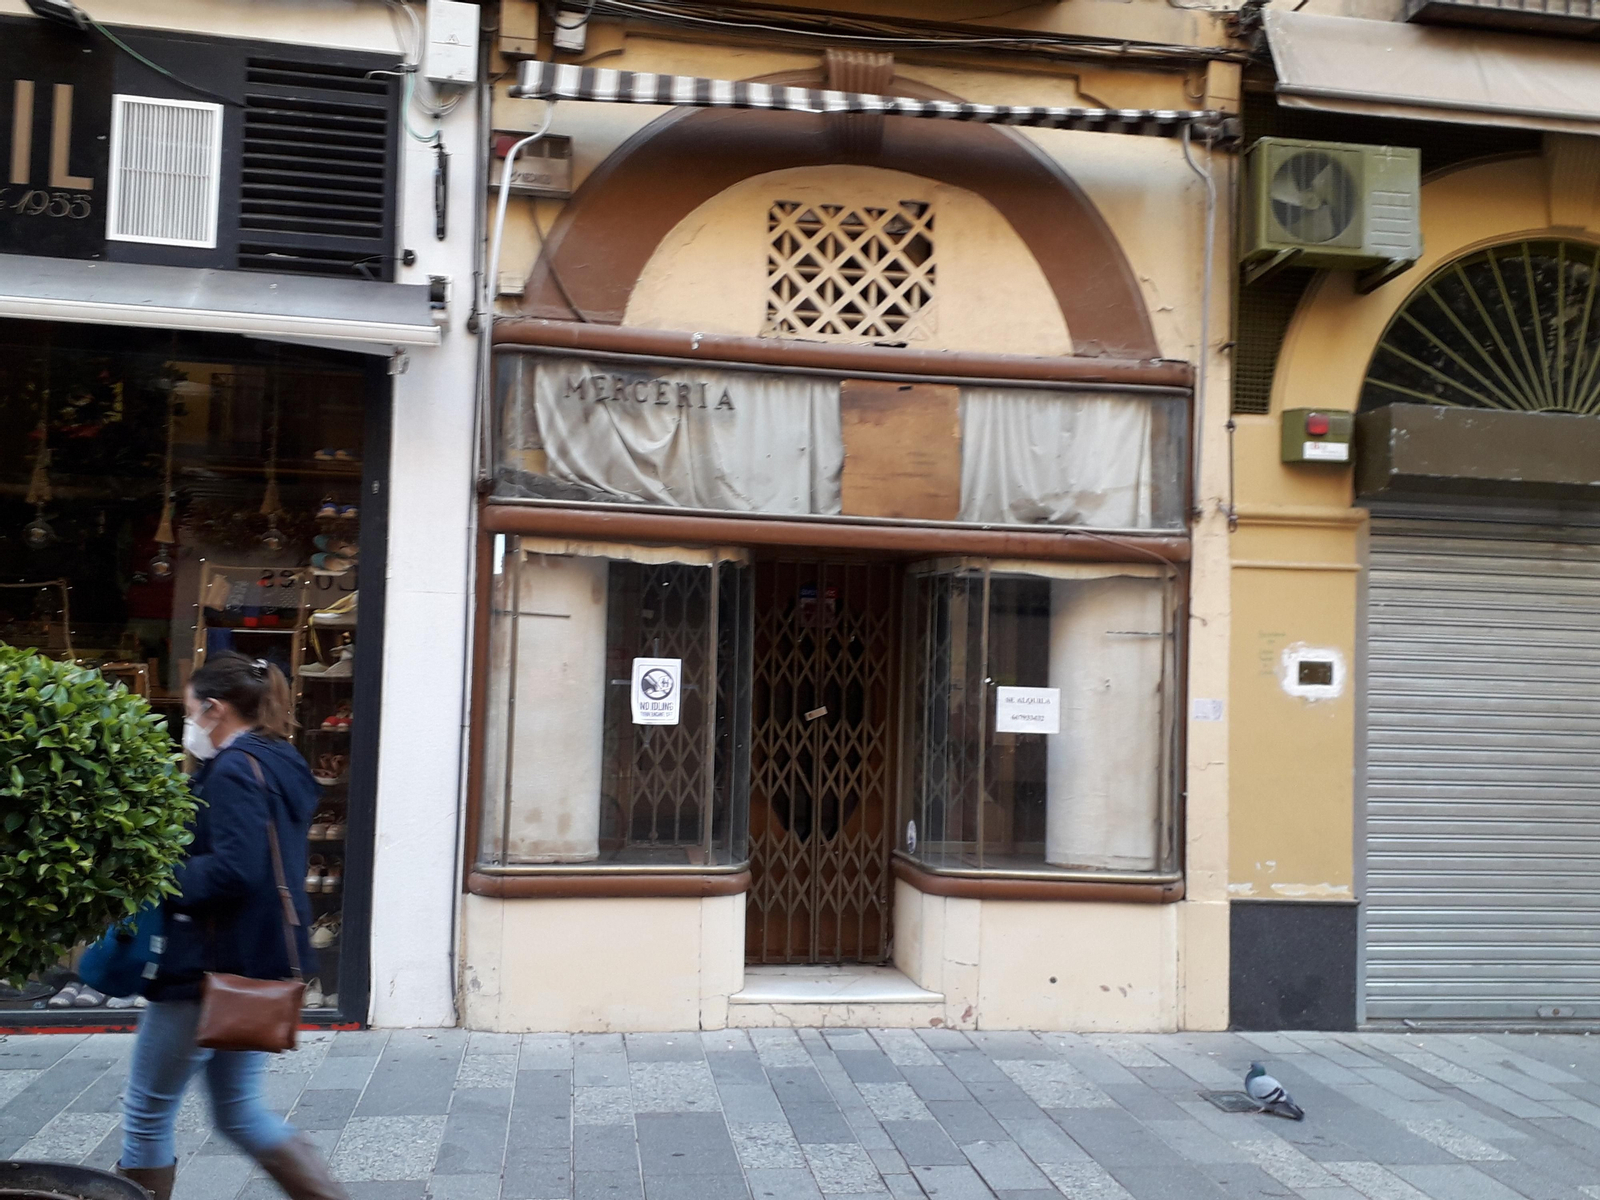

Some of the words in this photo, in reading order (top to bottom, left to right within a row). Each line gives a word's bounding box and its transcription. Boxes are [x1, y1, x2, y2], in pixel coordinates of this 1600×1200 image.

[563, 374, 736, 411] MERCERIA
[640, 701, 650, 711] NO
[651, 701, 674, 711] IDLING
